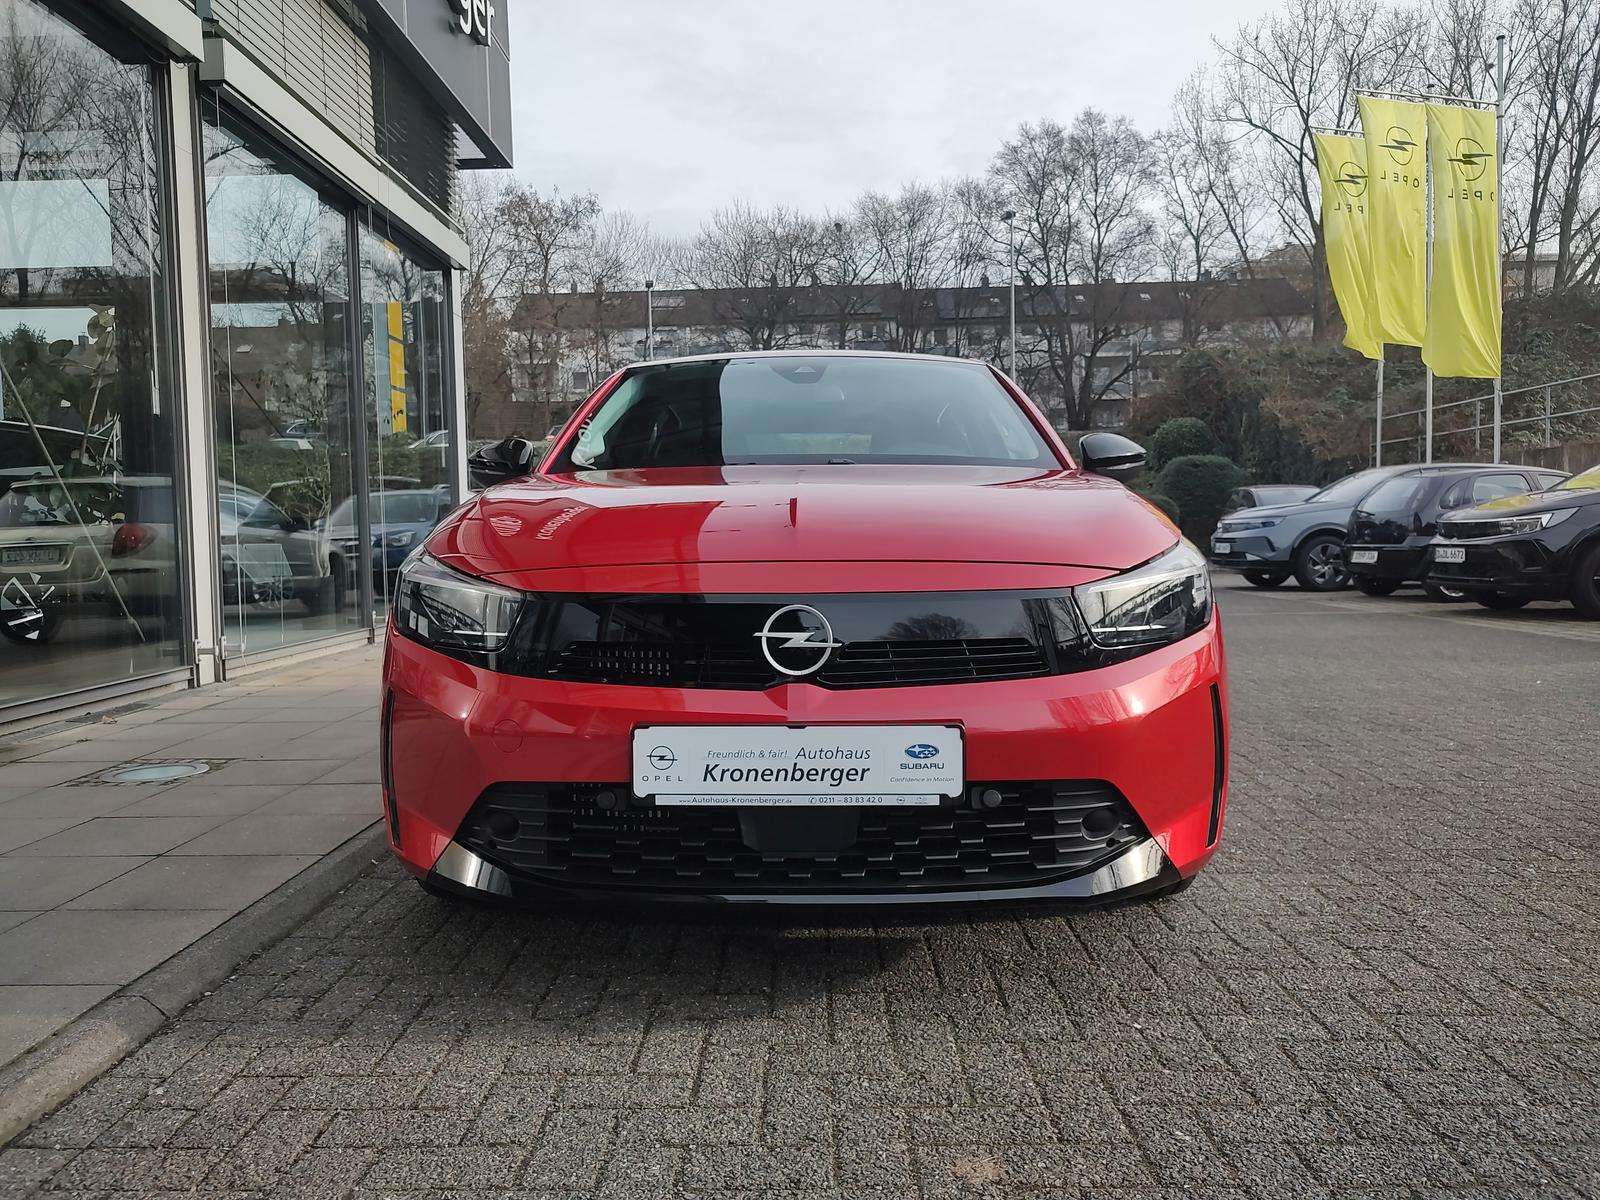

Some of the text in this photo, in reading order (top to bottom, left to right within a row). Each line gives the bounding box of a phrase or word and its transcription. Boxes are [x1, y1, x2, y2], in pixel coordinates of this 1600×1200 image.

[707, 746, 871, 760] Freundlich & fair! Autohaus
[900, 762, 945, 770] SUBARU
[702, 763, 871, 787] Kronenberger
[820, 796, 835, 804] 0211
[844, 796, 854, 804] 83
[855, 796, 865, 804] 83
